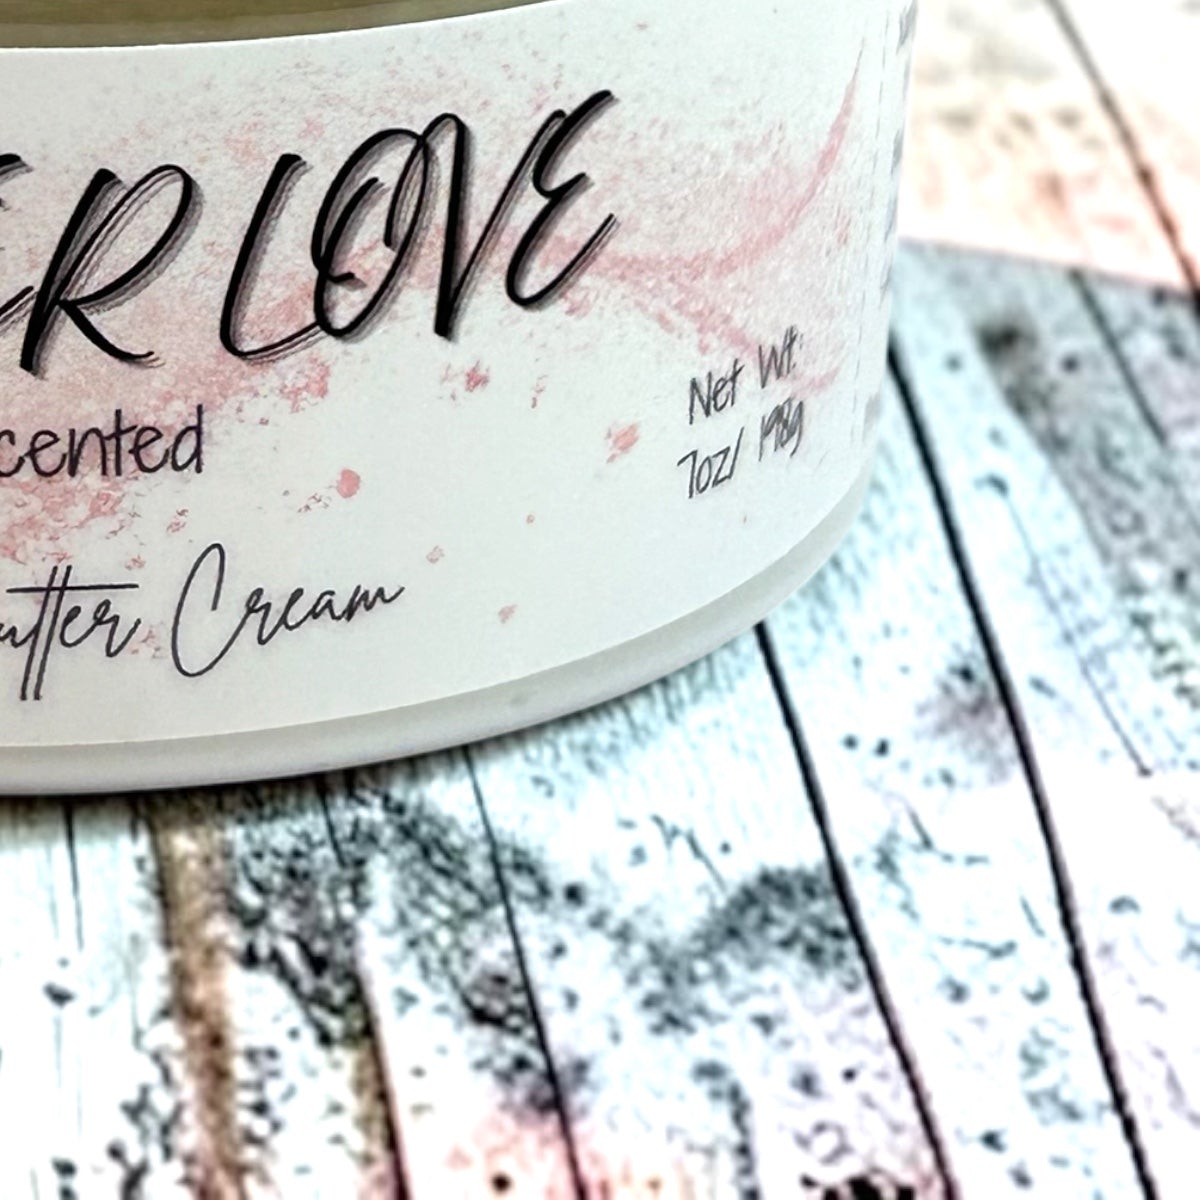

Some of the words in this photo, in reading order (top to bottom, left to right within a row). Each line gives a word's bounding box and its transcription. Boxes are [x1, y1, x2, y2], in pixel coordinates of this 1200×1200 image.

[219, 89, 618, 363] LOVE
[688, 357, 745, 426] Net
[170, 543, 405, 679] Cream
